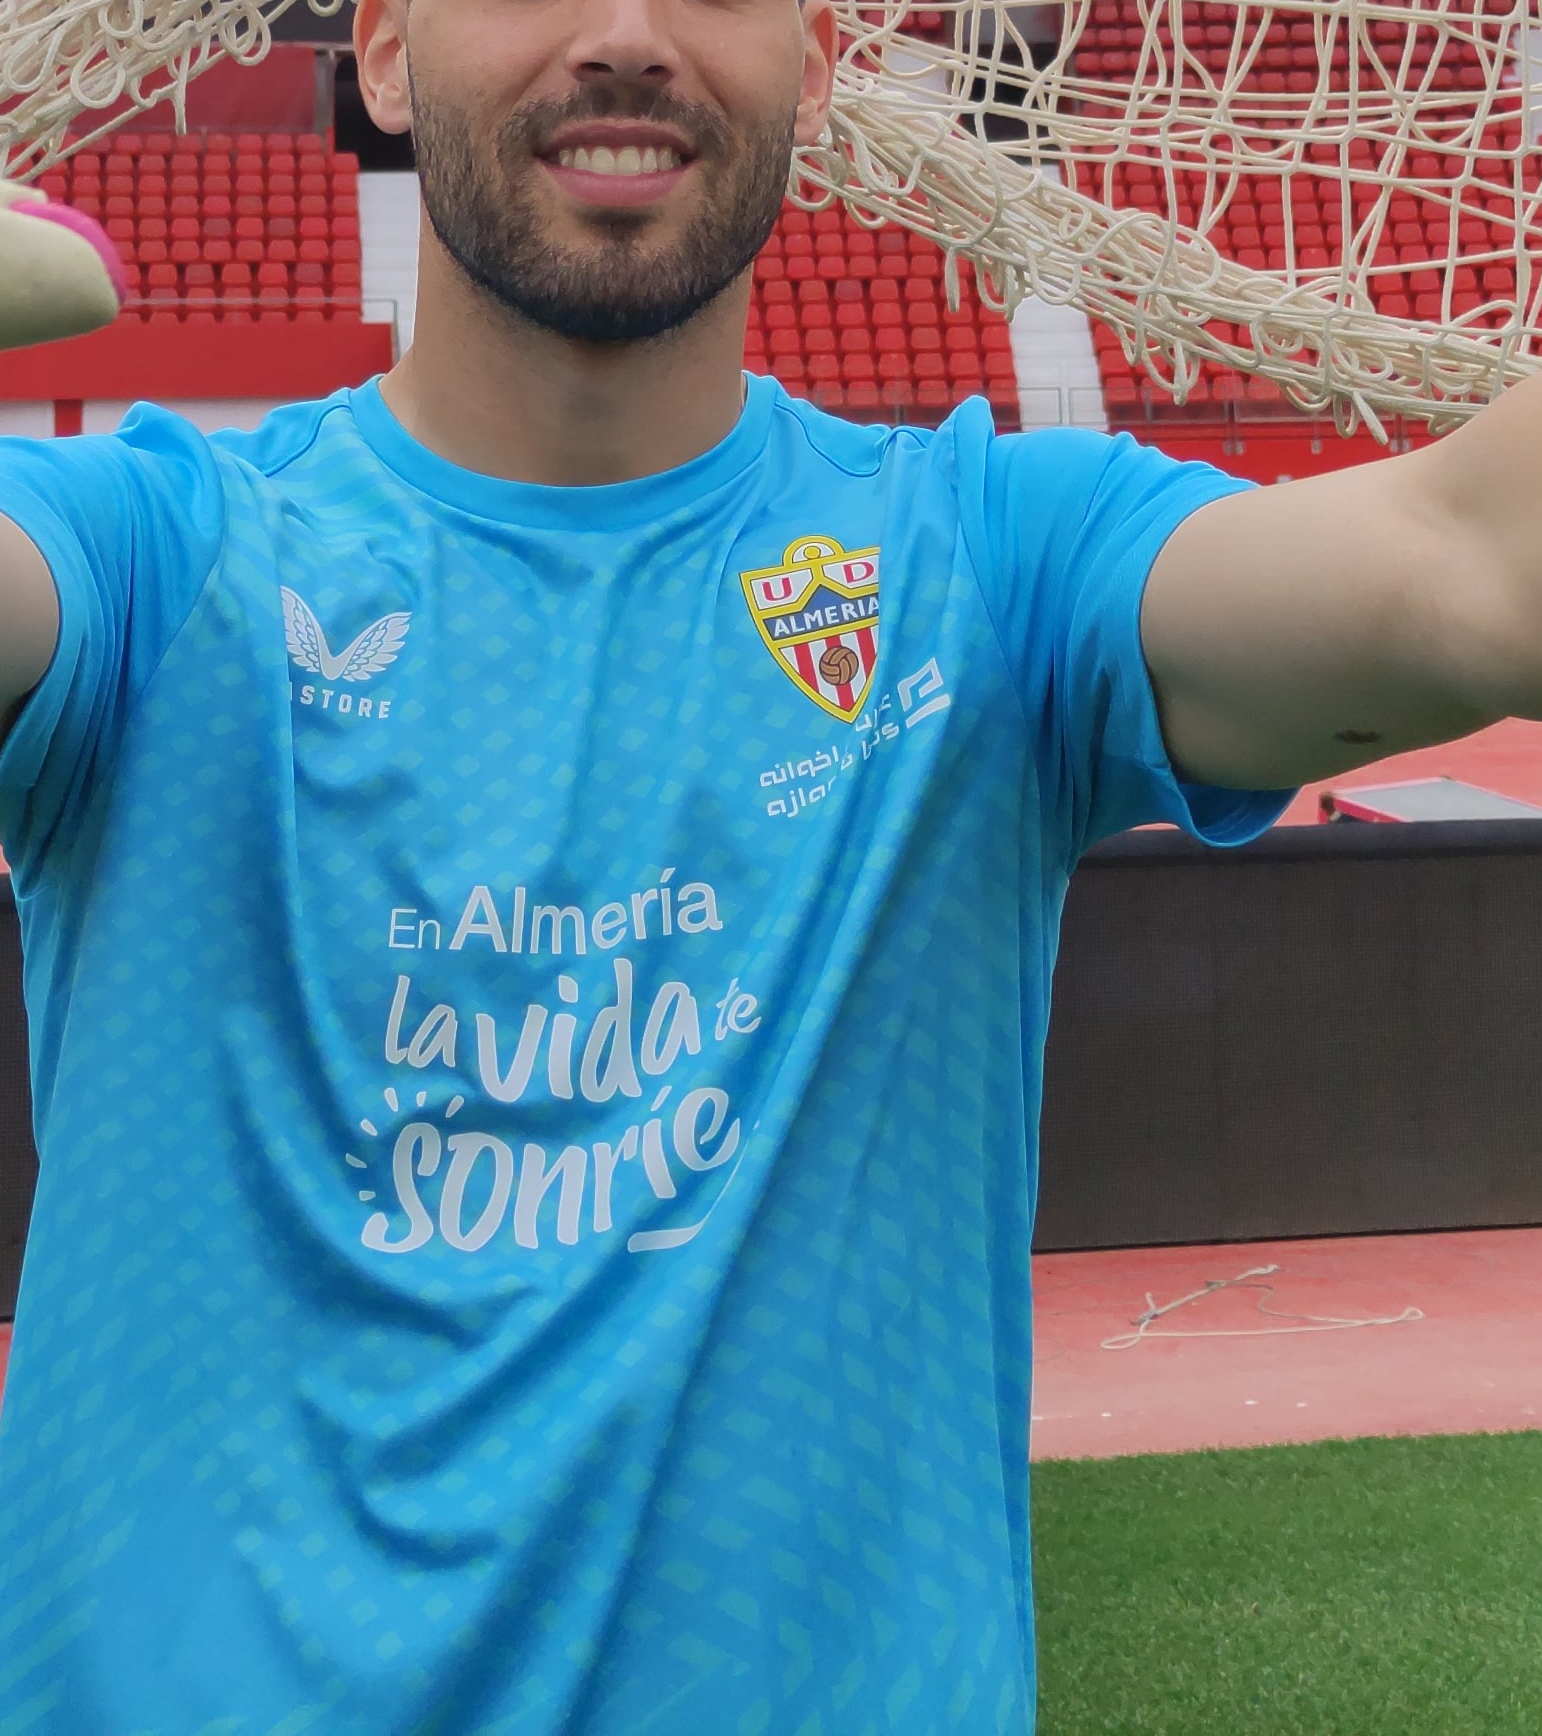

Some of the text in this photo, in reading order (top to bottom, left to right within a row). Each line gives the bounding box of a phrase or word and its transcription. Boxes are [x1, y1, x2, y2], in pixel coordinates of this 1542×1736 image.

[762, 561, 875, 602] U D
[773, 596, 879, 638] ALMERIA
[289, 681, 392, 719] STORE
[387, 867, 724, 955] En Almería
[384, 957, 762, 1103] la vida te
